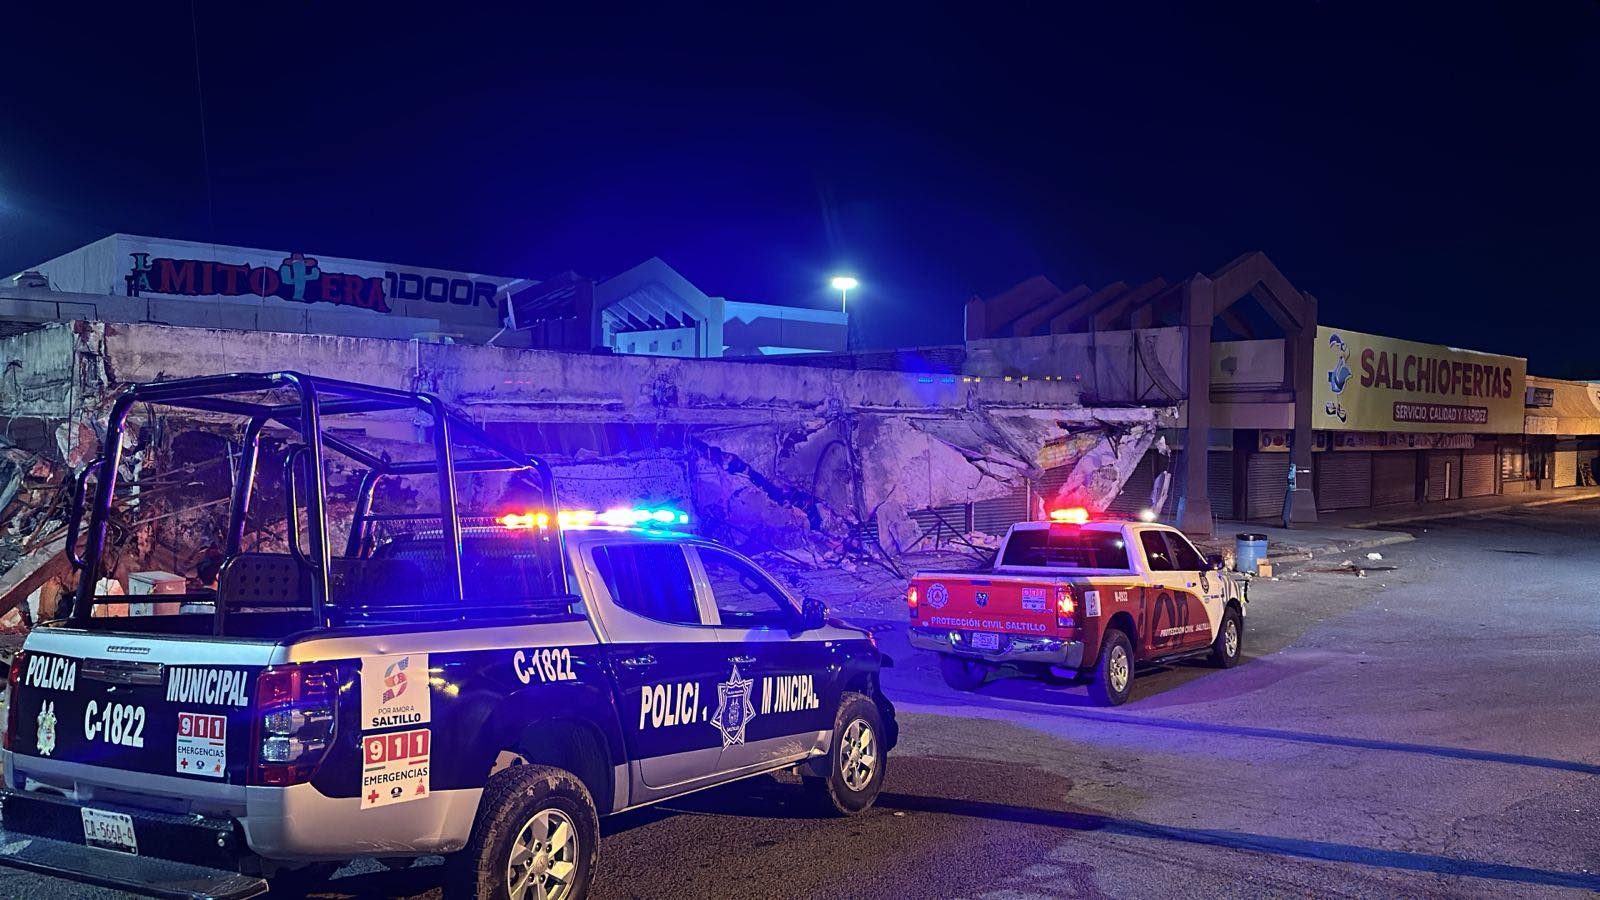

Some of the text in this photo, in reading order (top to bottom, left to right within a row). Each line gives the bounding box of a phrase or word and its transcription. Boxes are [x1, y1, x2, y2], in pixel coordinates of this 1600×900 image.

[1360, 348, 1512, 399] SALCHIOFERTAS
[1429, 407, 1457, 422] CALIDAD
[1457, 409, 1463, 420] Y
[1463, 408, 1487, 423] RAPIDEZ
[931, 616, 1046, 632] PROTECCIÓN CIVIL SALTILLO
[513, 648, 577, 684] C-1822
[166, 667, 249, 707] MUNICIPAL
[85, 700, 146, 748] C-1822
[181, 717, 221, 737] 911
[372, 713, 421, 727] SALTILLO
[177, 745, 225, 758] EMERGENCIAS
[369, 735, 423, 761] 911
[364, 767, 428, 786] EMERGENCIAS
